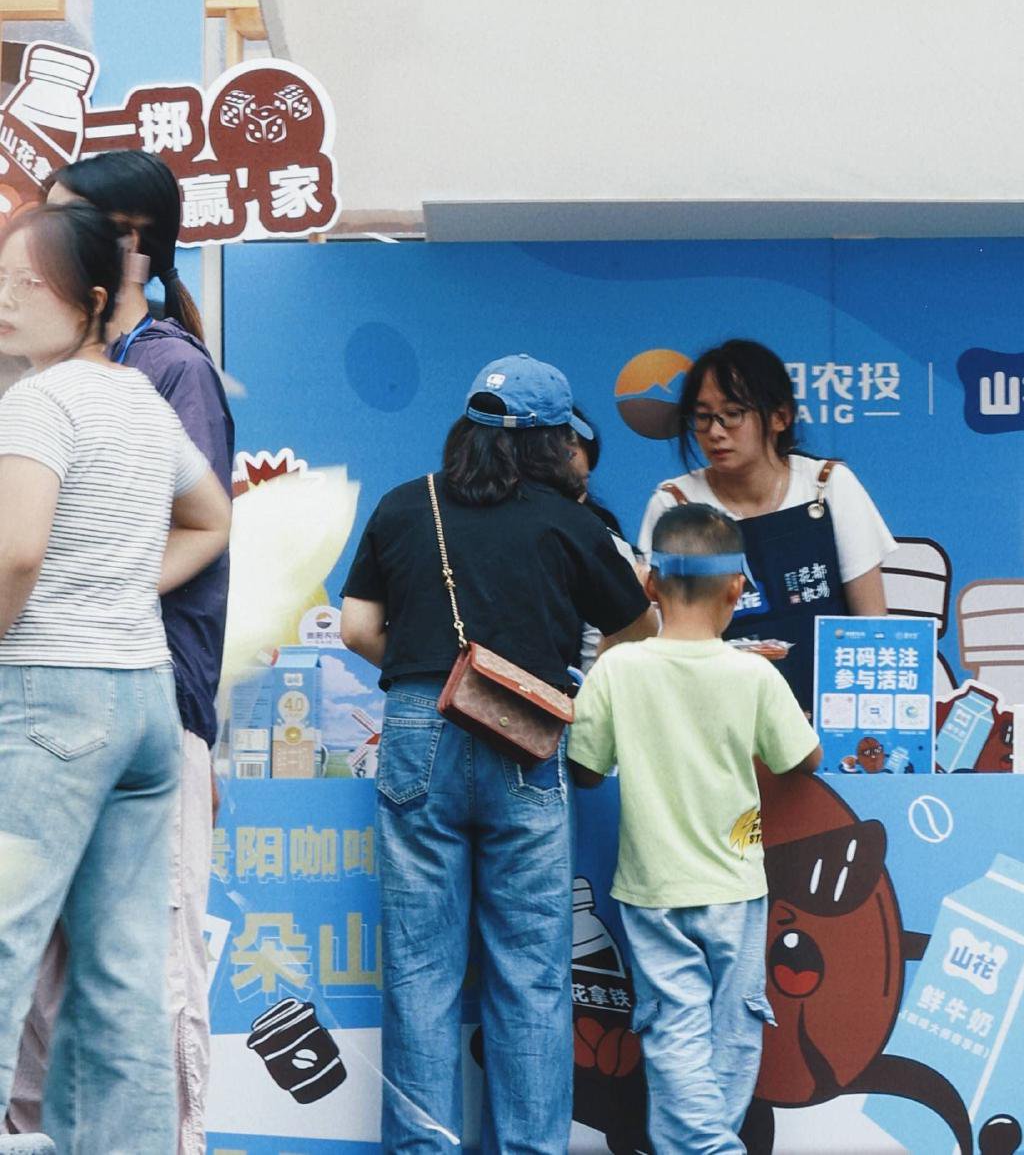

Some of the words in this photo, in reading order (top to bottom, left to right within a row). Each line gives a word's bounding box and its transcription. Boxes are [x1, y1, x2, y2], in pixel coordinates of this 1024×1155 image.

[795, 405, 854, 424] AIG
[835, 647, 919, 668] 扫码关注
[835, 668, 918, 690] 参与活动
[950, 945, 997, 980] 山花
[572, 983, 632, 1008] 花拿铁
[917, 984, 994, 1037] 鲜牛奶
